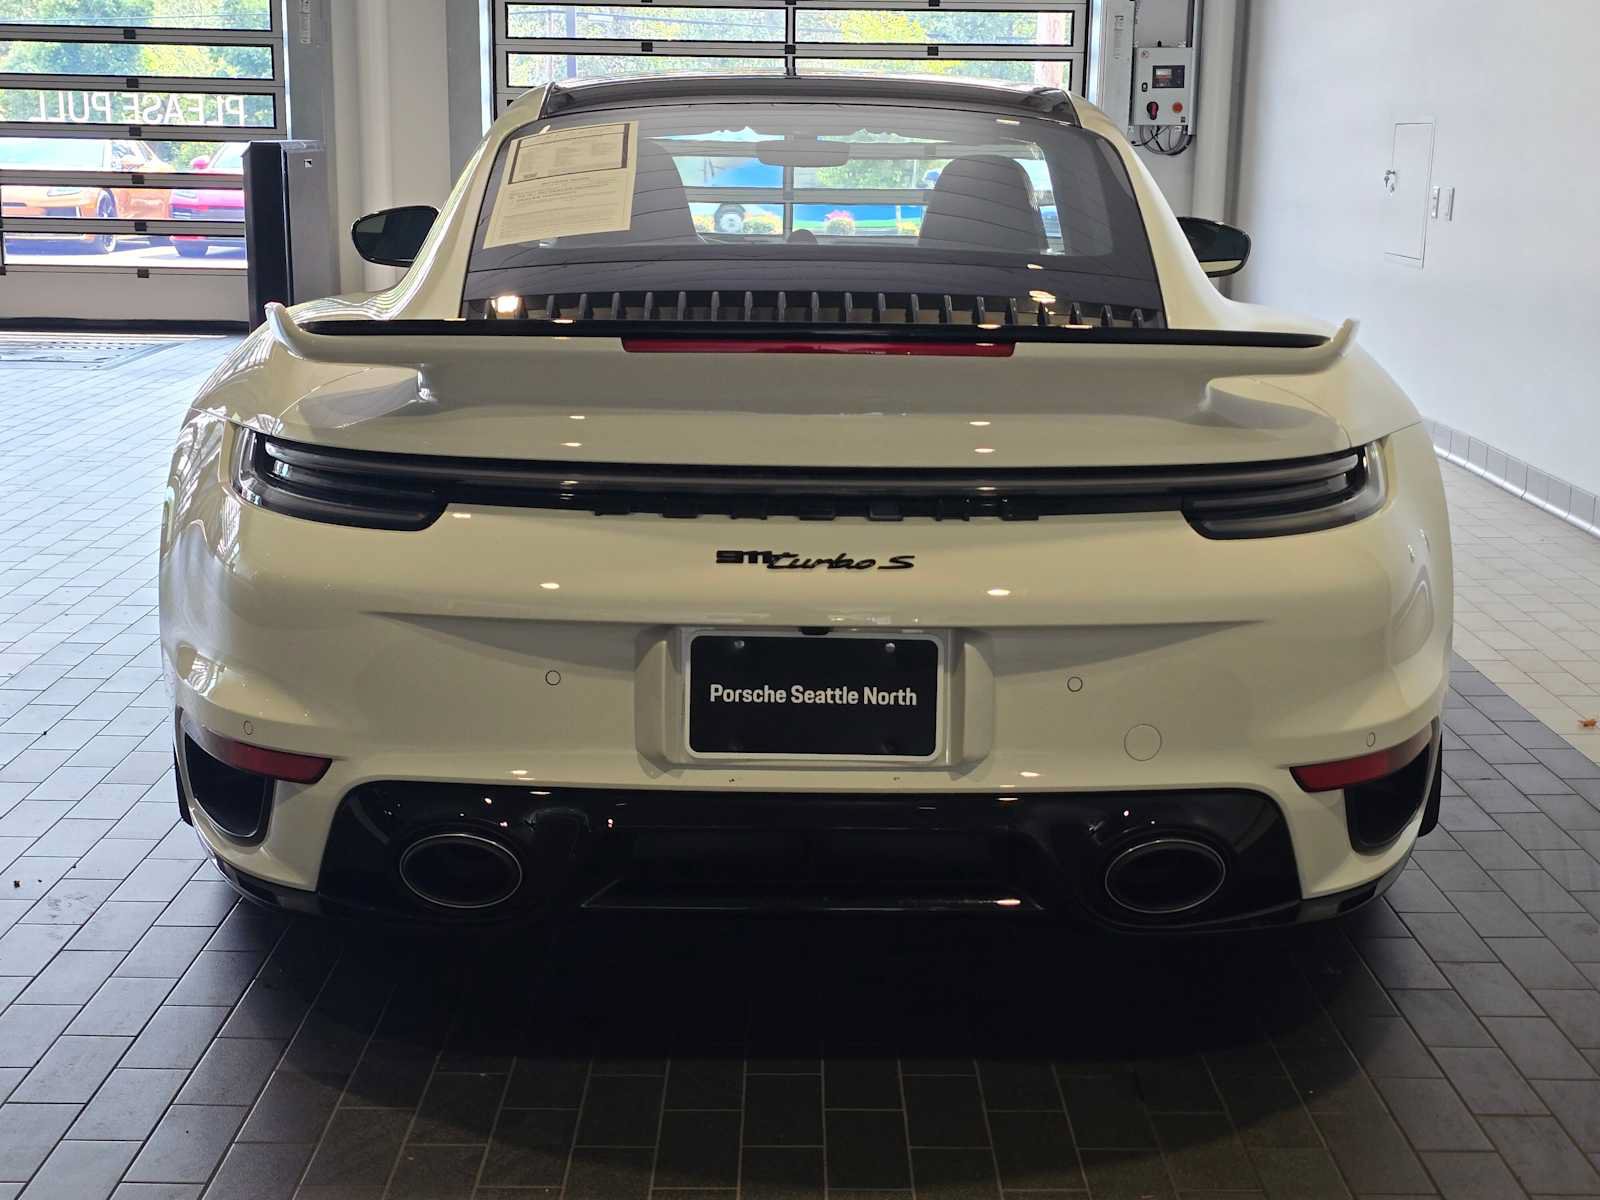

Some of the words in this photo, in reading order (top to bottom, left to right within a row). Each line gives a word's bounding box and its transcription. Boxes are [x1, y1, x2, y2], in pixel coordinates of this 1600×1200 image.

[716, 550, 773, 564] 911
[877, 555, 916, 570] S
[710, 683, 787, 703] Porsche
[790, 685, 859, 705] Seattle
[863, 686, 918, 706] North
